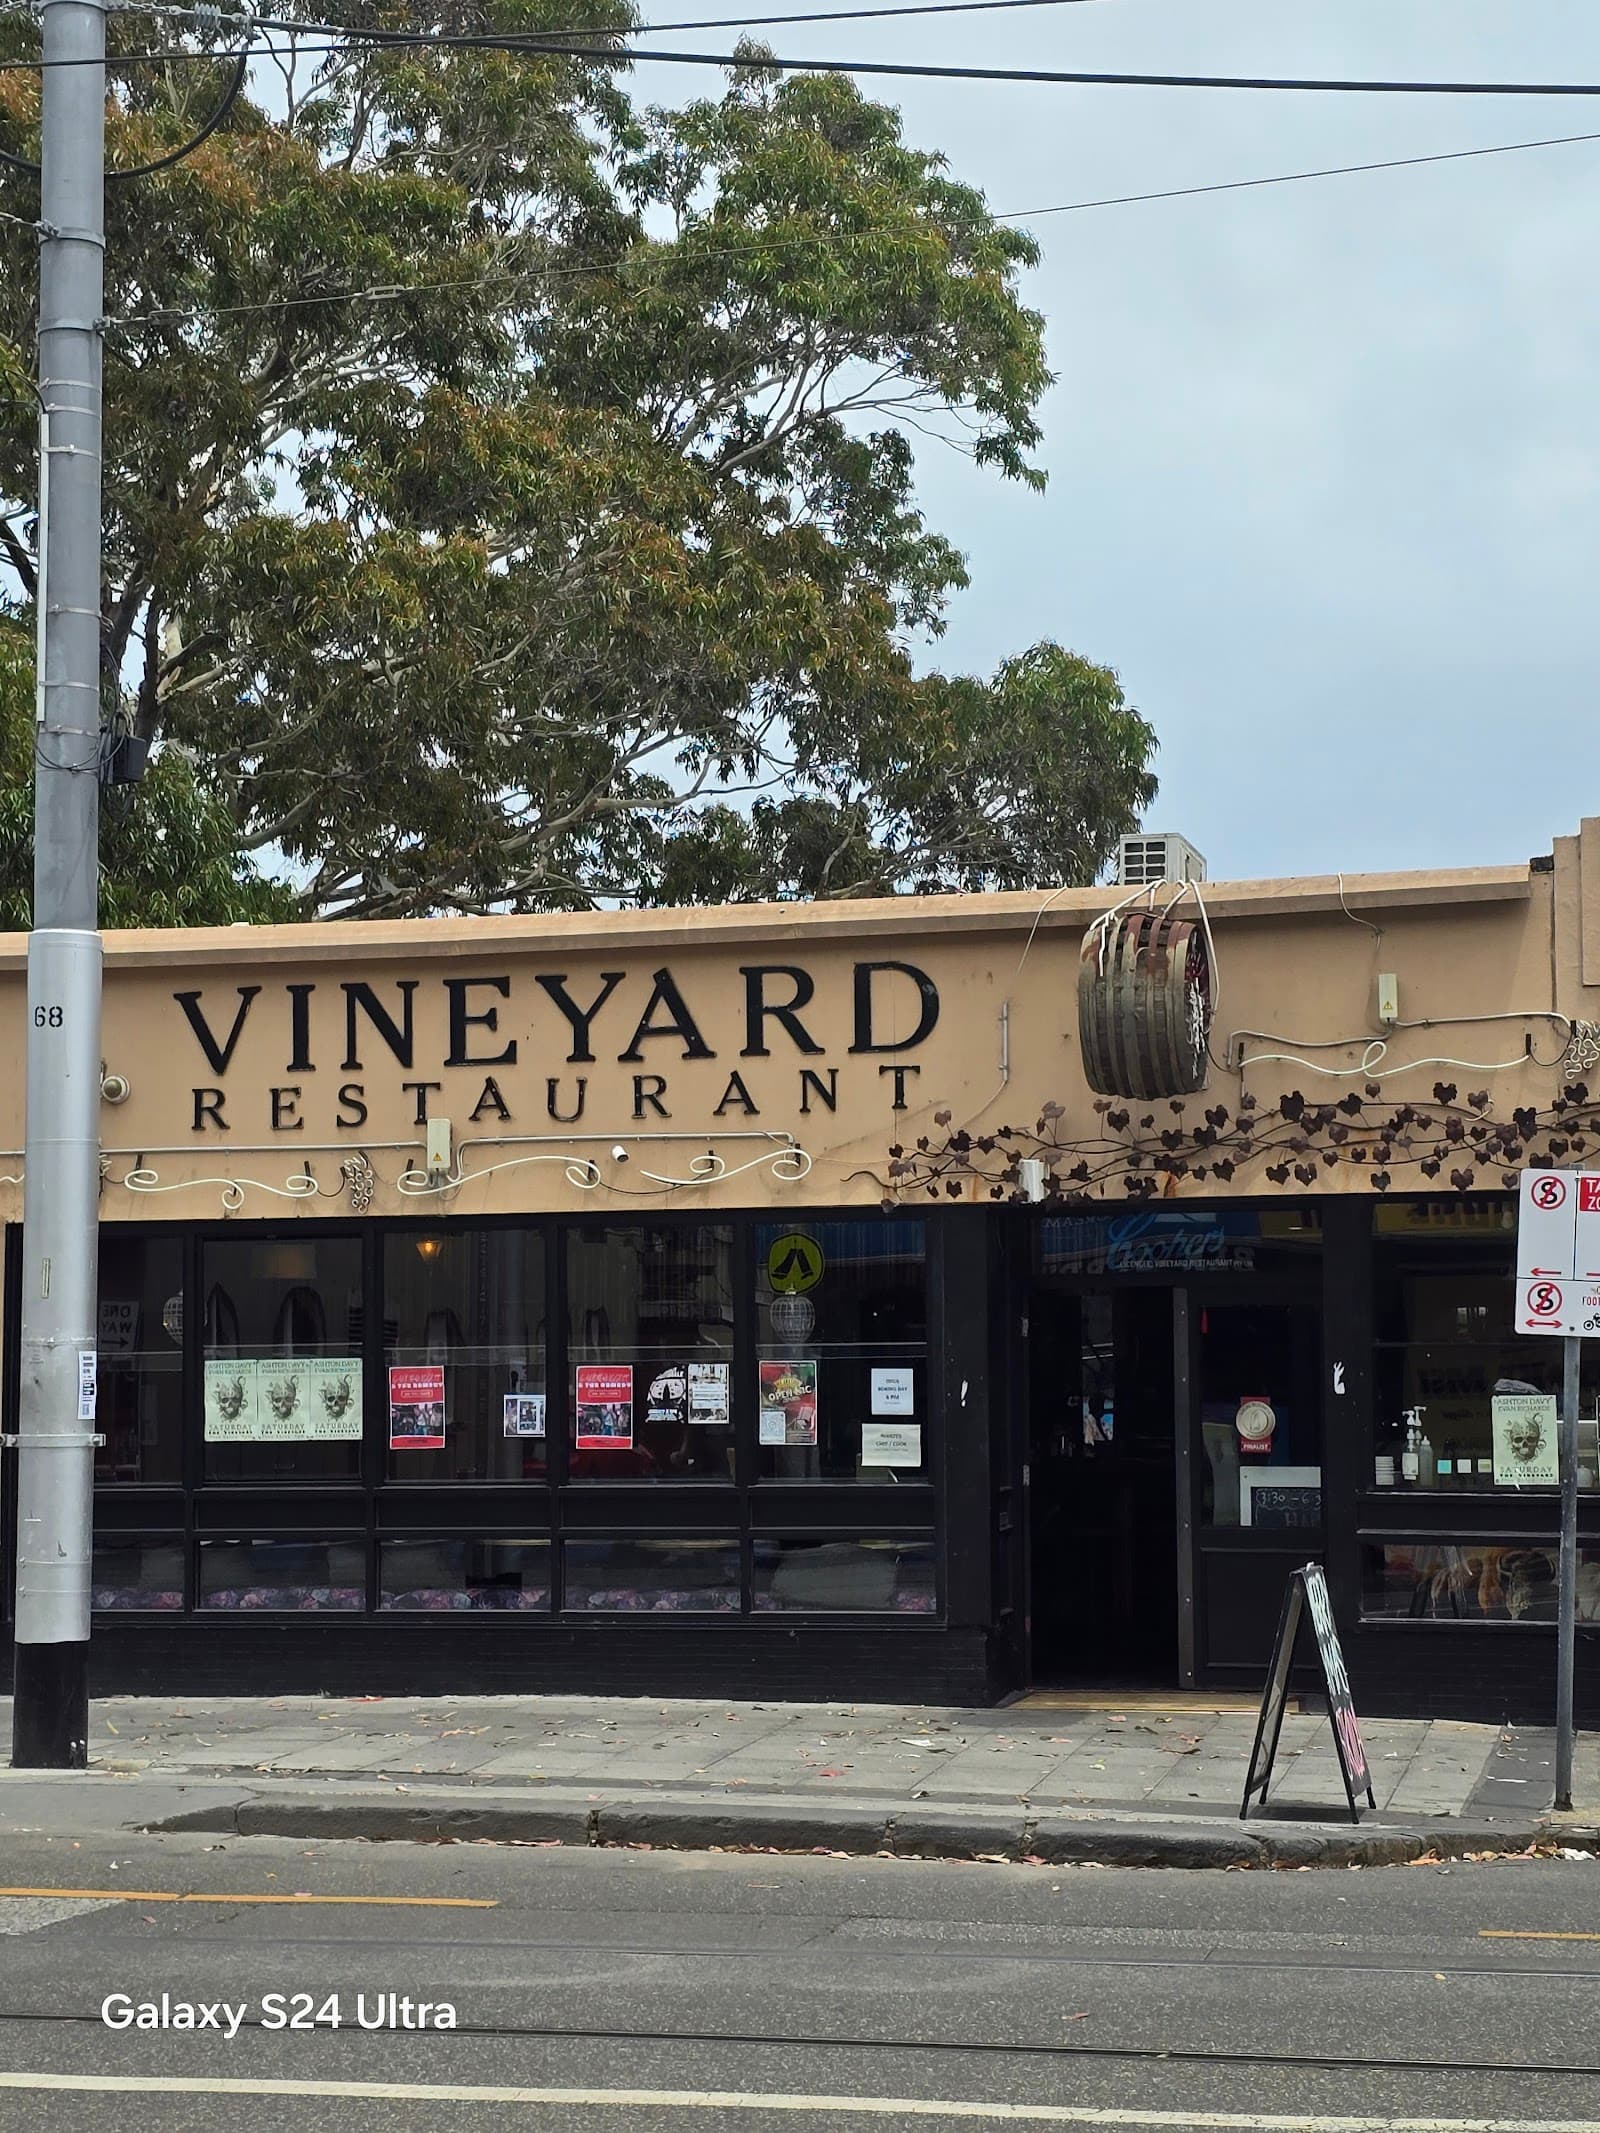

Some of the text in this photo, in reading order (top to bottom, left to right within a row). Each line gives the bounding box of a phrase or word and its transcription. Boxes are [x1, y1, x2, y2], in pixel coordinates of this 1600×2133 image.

[34, 1006, 64, 1028] 68
[173, 961, 941, 1076] VINEYARD
[191, 1065, 921, 1130] RESTAURANT
[768, 1389, 793, 1401] OPEN
[1530, 1397, 1551, 1405] DAVY
[1500, 1465, 1553, 1474] SATURDAY
